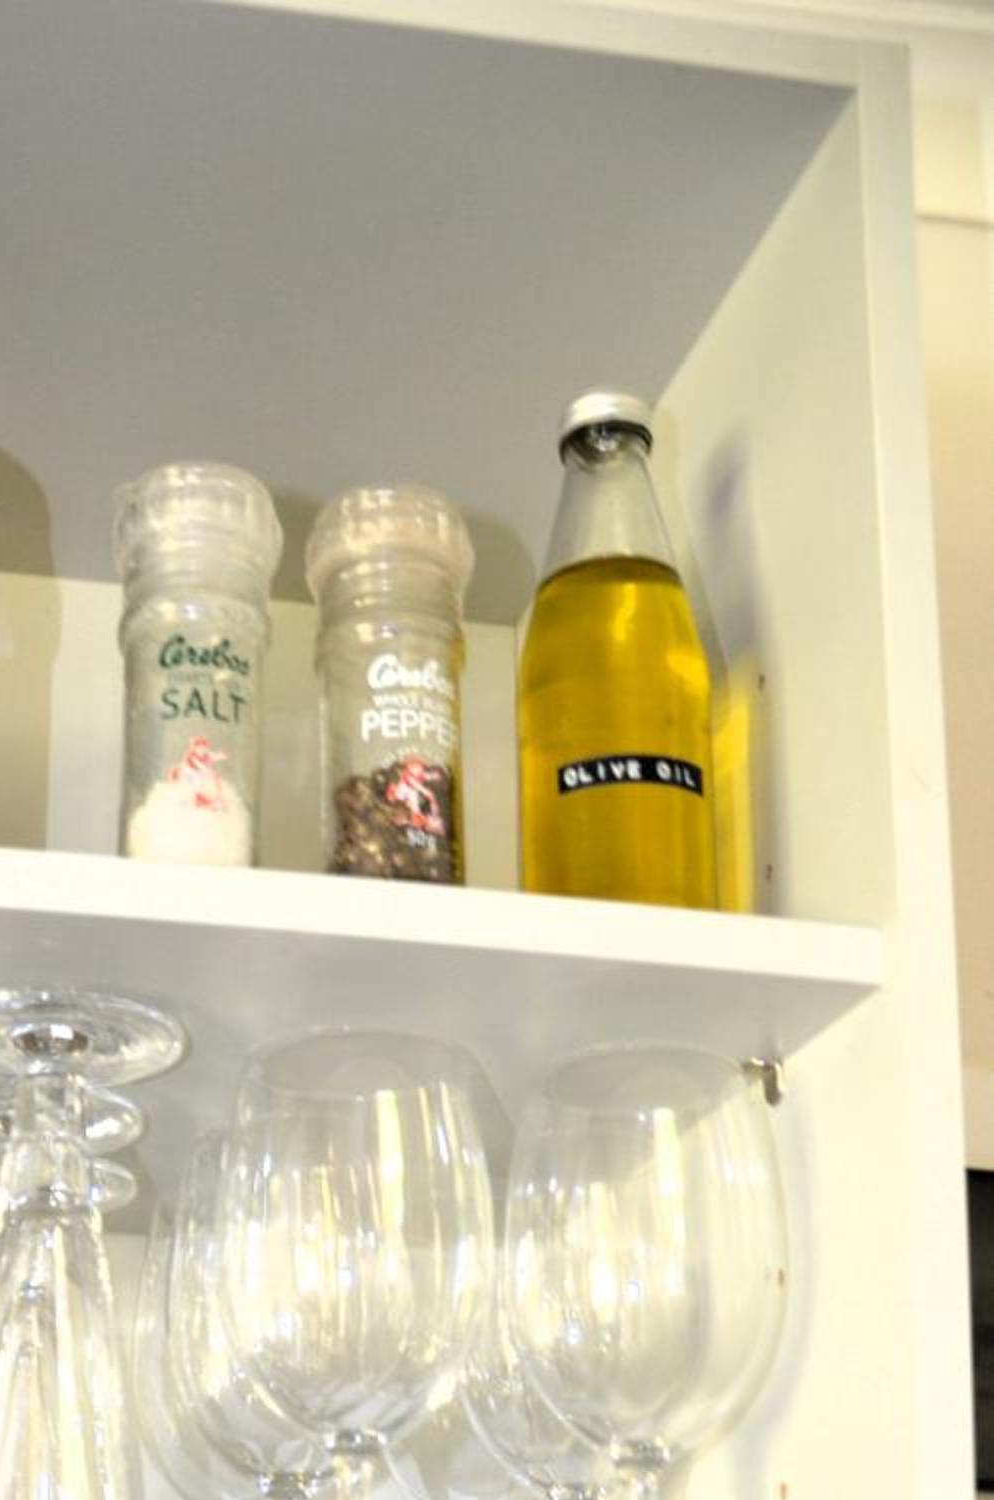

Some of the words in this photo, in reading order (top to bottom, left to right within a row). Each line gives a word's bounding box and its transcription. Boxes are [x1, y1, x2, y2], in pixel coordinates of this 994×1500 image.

[160, 687, 247, 724] SALT
[361, 707, 455, 747] PEPPE
[563, 758, 643, 787] OLIVE
[655, 760, 696, 787] OIL
